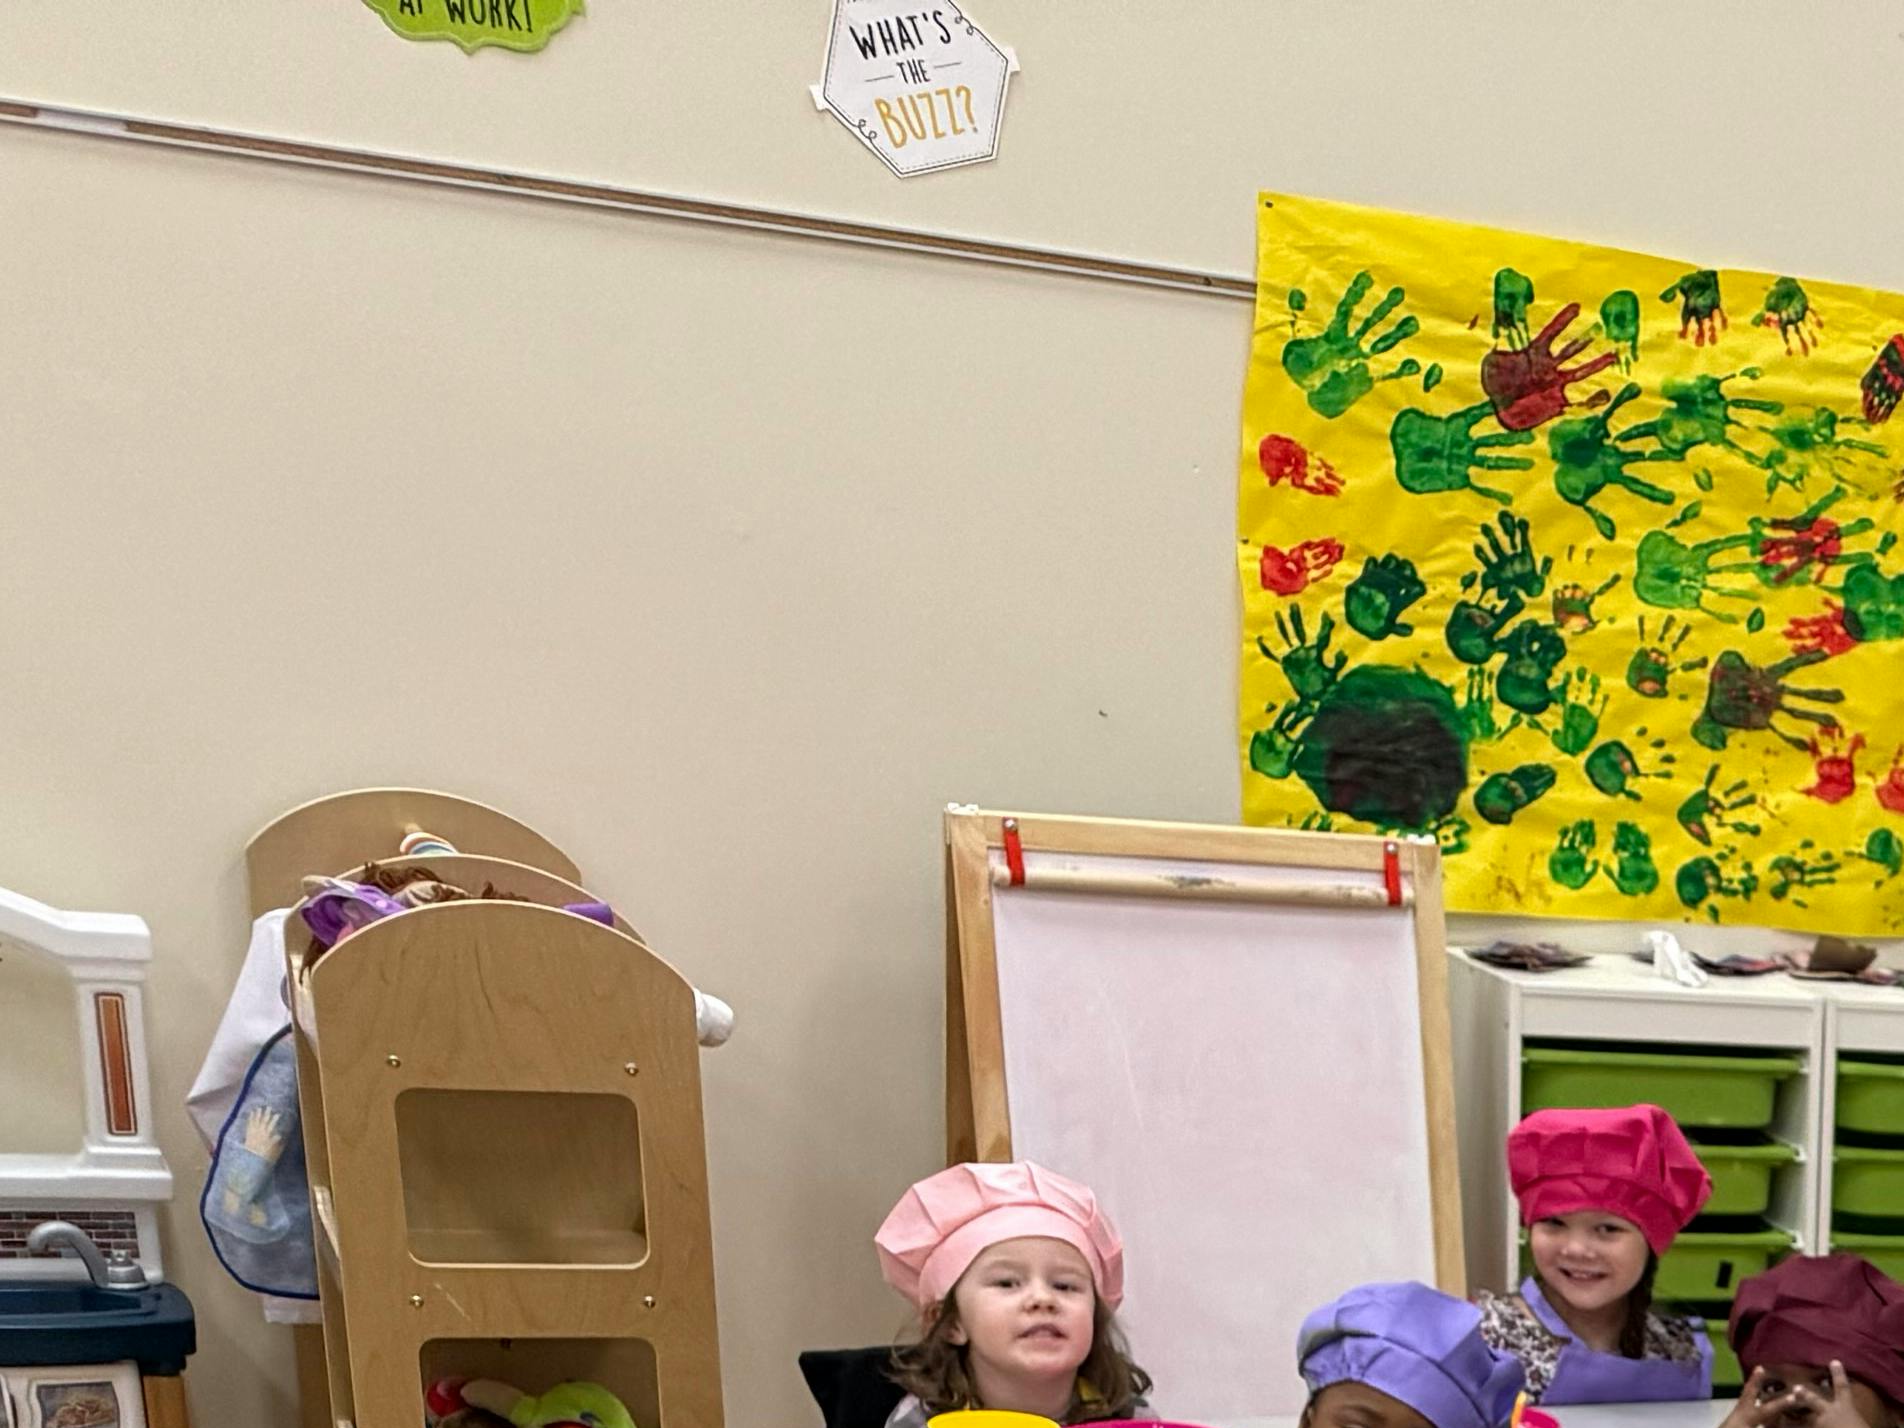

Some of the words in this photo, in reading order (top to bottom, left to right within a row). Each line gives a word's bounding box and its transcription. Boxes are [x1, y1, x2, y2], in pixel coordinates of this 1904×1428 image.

[849, 9, 951, 60] WHAT'S
[896, 59, 931, 85] THE
[874, 84, 978, 149] BUZZ?
